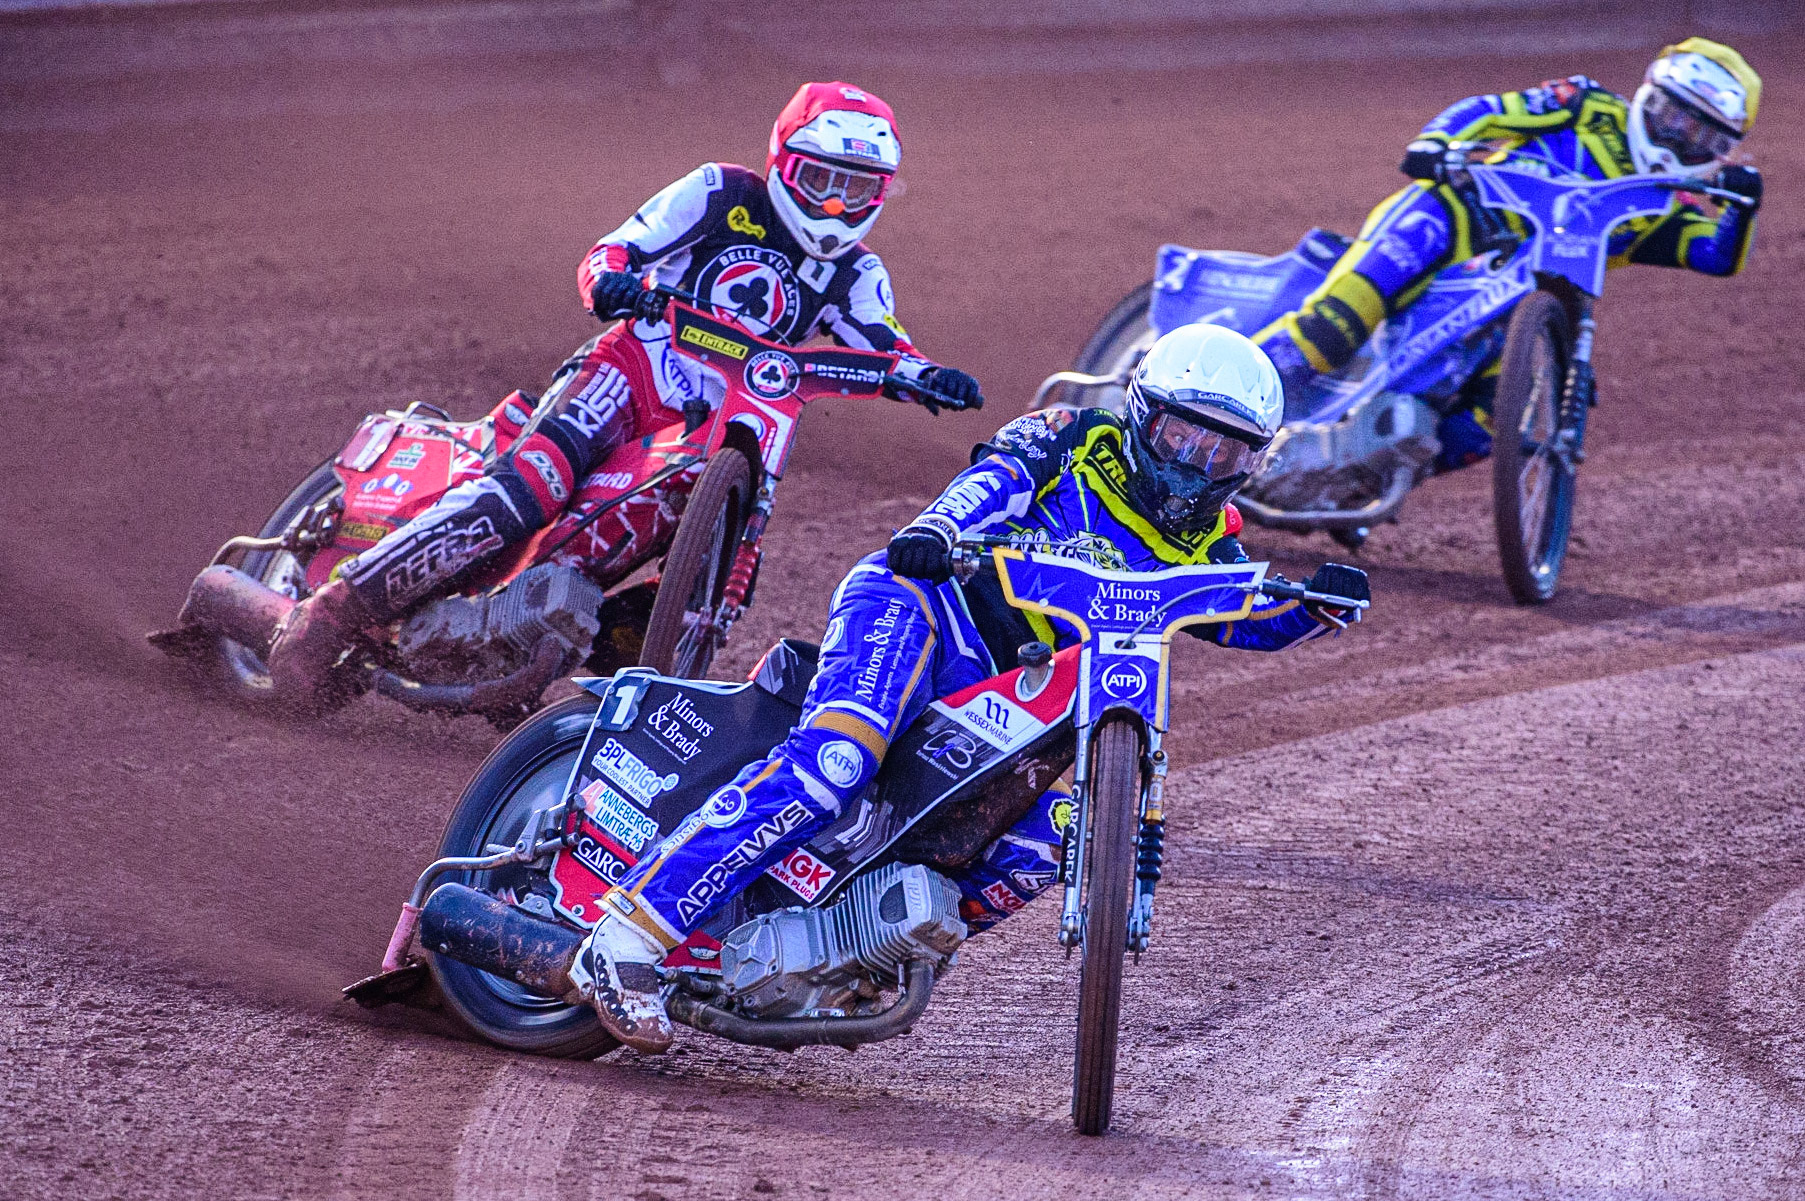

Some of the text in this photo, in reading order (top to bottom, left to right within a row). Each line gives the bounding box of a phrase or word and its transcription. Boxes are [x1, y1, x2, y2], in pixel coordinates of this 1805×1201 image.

[718, 250, 797, 317] BELLE VUE ACES
[1087, 598, 1168, 628] & Brady
[1096, 582, 1161, 602] Minors
[863, 628, 892, 645] &
[855, 646, 886, 702] Minors
[1107, 674, 1141, 689] ATPI
[610, 686, 638, 725] 1
[667, 692, 715, 738] Minors
[648, 704, 670, 731] &
[663, 721, 702, 761] Brady
[594, 757, 651, 805] YOUR COOLEST PARTNER
[599, 789, 657, 839] ANNEBERGS
[1064, 784, 1082, 883] GARCAREK
[577, 837, 627, 882] GARC
[769, 865, 815, 900] PARK PLUGS
